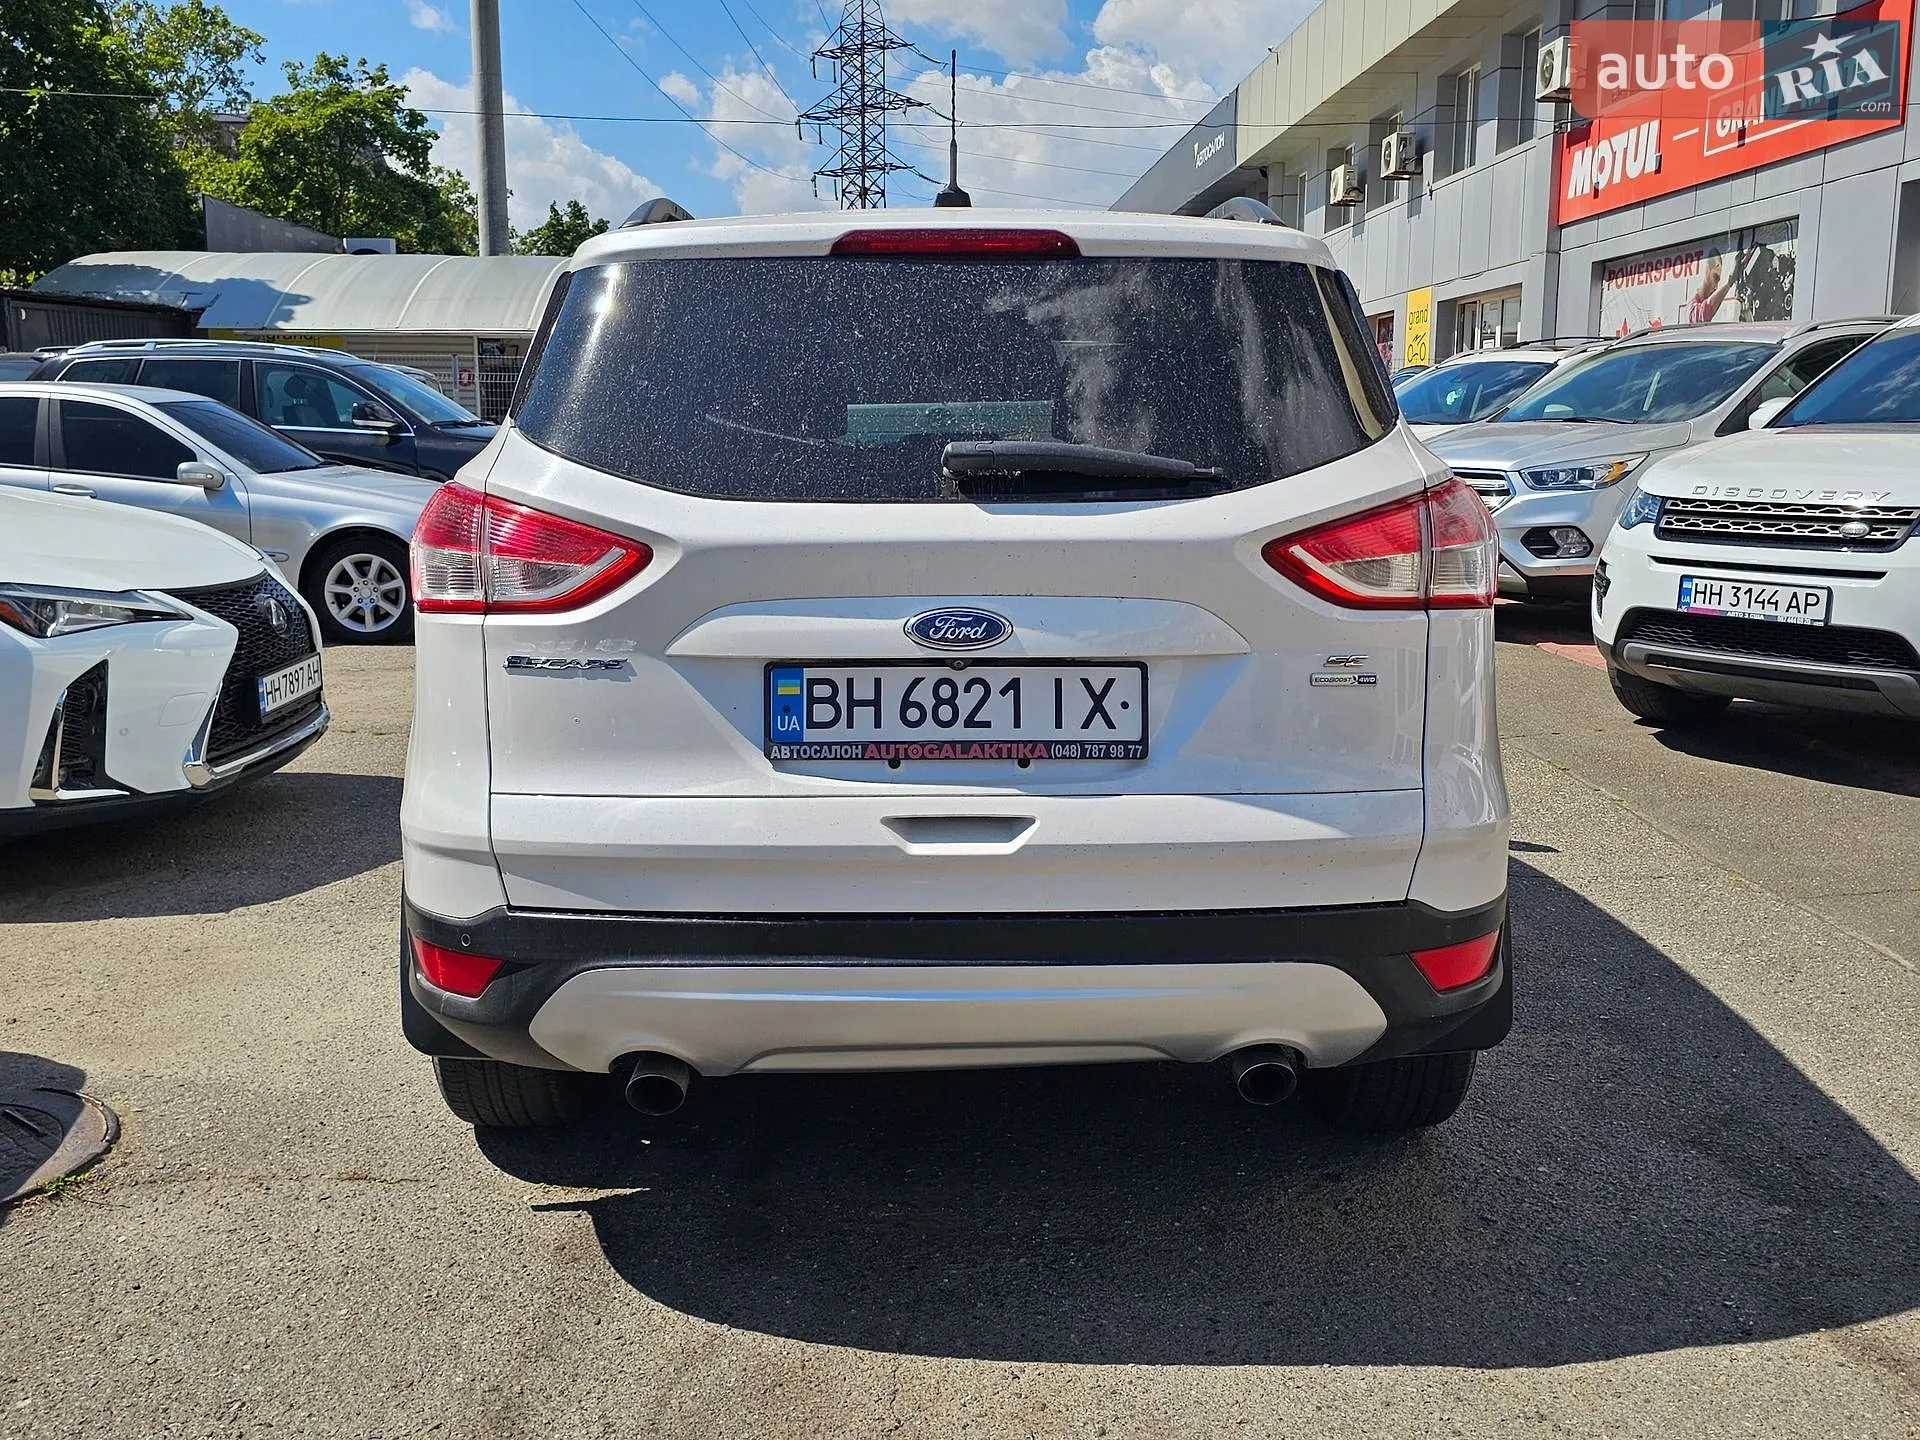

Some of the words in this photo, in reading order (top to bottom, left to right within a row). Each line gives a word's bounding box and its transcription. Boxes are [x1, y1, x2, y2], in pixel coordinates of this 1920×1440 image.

[1567, 119, 1661, 200] MOTUL
[1607, 250, 1704, 291] POWERSPORT
[1408, 303, 1429, 330] grand
[1691, 485, 1893, 502] DISCOVERY
[1681, 595, 1690, 603] UA
[1728, 586, 1780, 612] 3144
[929, 616, 988, 639] Ford
[282, 666, 305, 698] 7897
[900, 677, 1021, 729] 6821
[777, 715, 801, 731] UA
[770, 745, 862, 759] АВТОСАЛОН
[864, 743, 1049, 759] AUTOGALAKTIKA
[1051, 743, 1081, 760] (048)
[1084, 745, 1106, 759] 787
[1109, 745, 1124, 759] 98
[1127, 745, 1143, 759] 77
